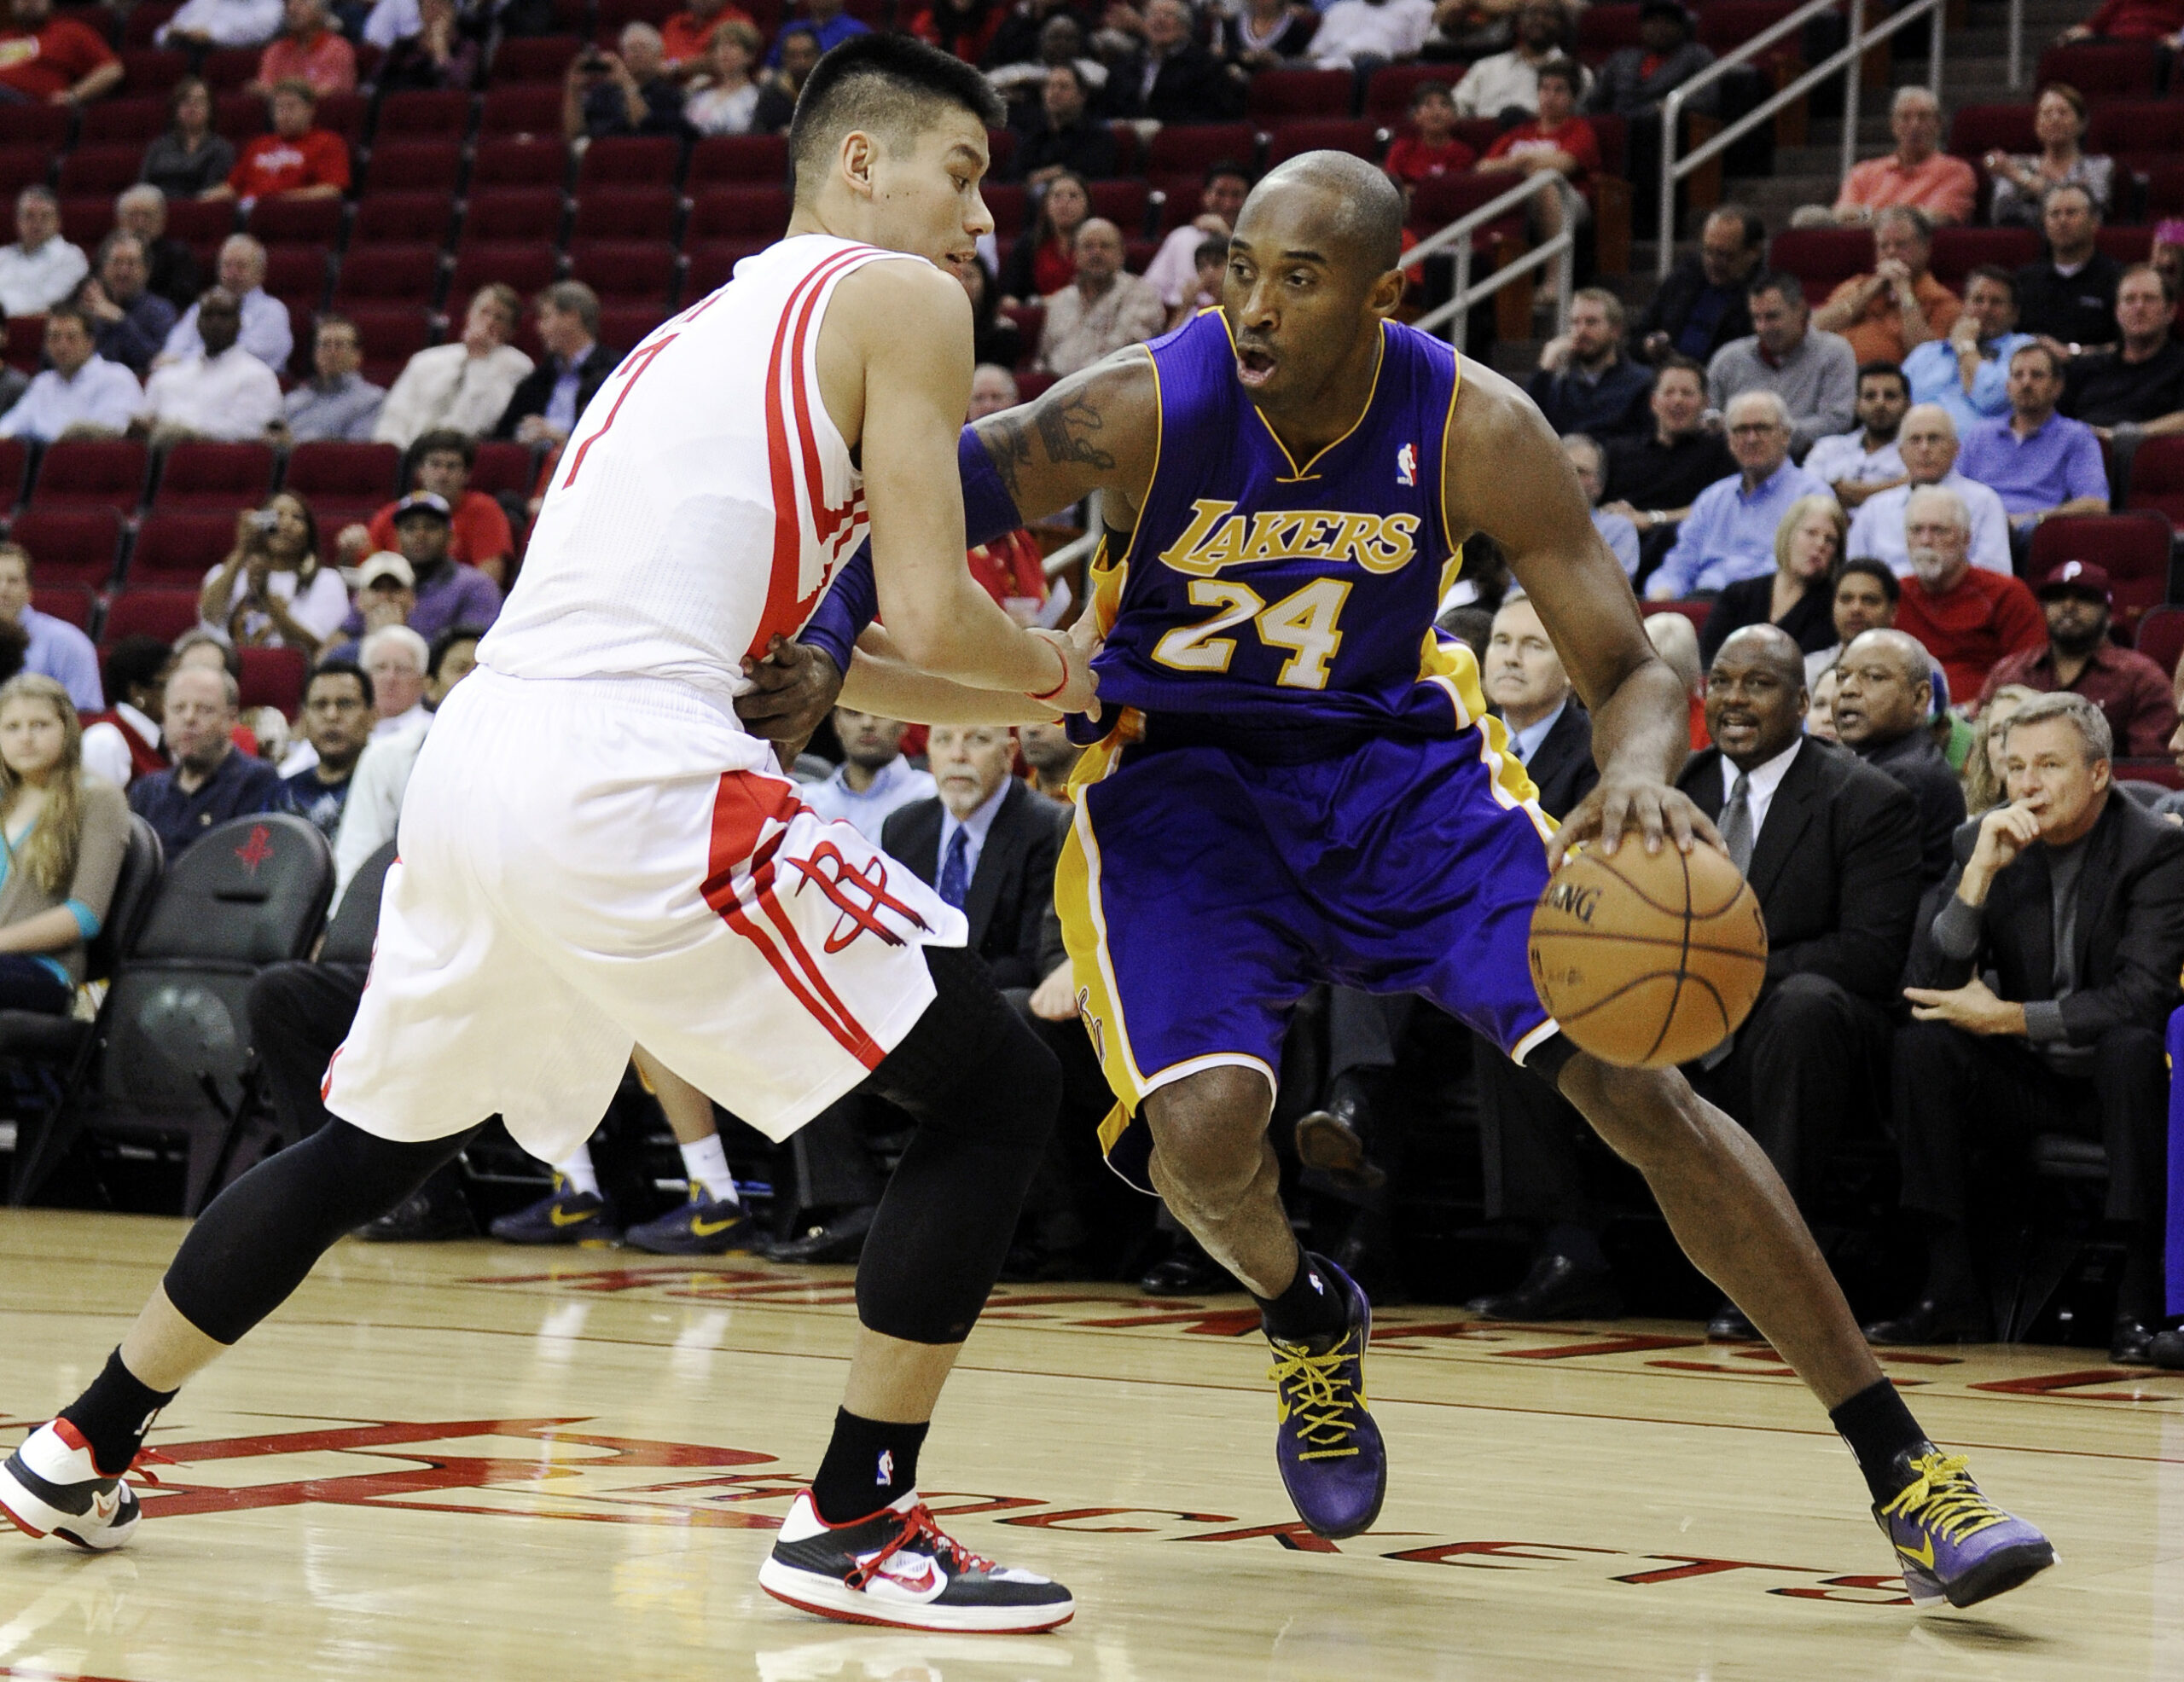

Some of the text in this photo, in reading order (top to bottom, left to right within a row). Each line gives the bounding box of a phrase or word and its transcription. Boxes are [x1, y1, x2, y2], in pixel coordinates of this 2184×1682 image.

[561, 332, 681, 490] 7
[1158, 498, 1422, 578] LAKERS
[1151, 577, 1354, 690] 24
